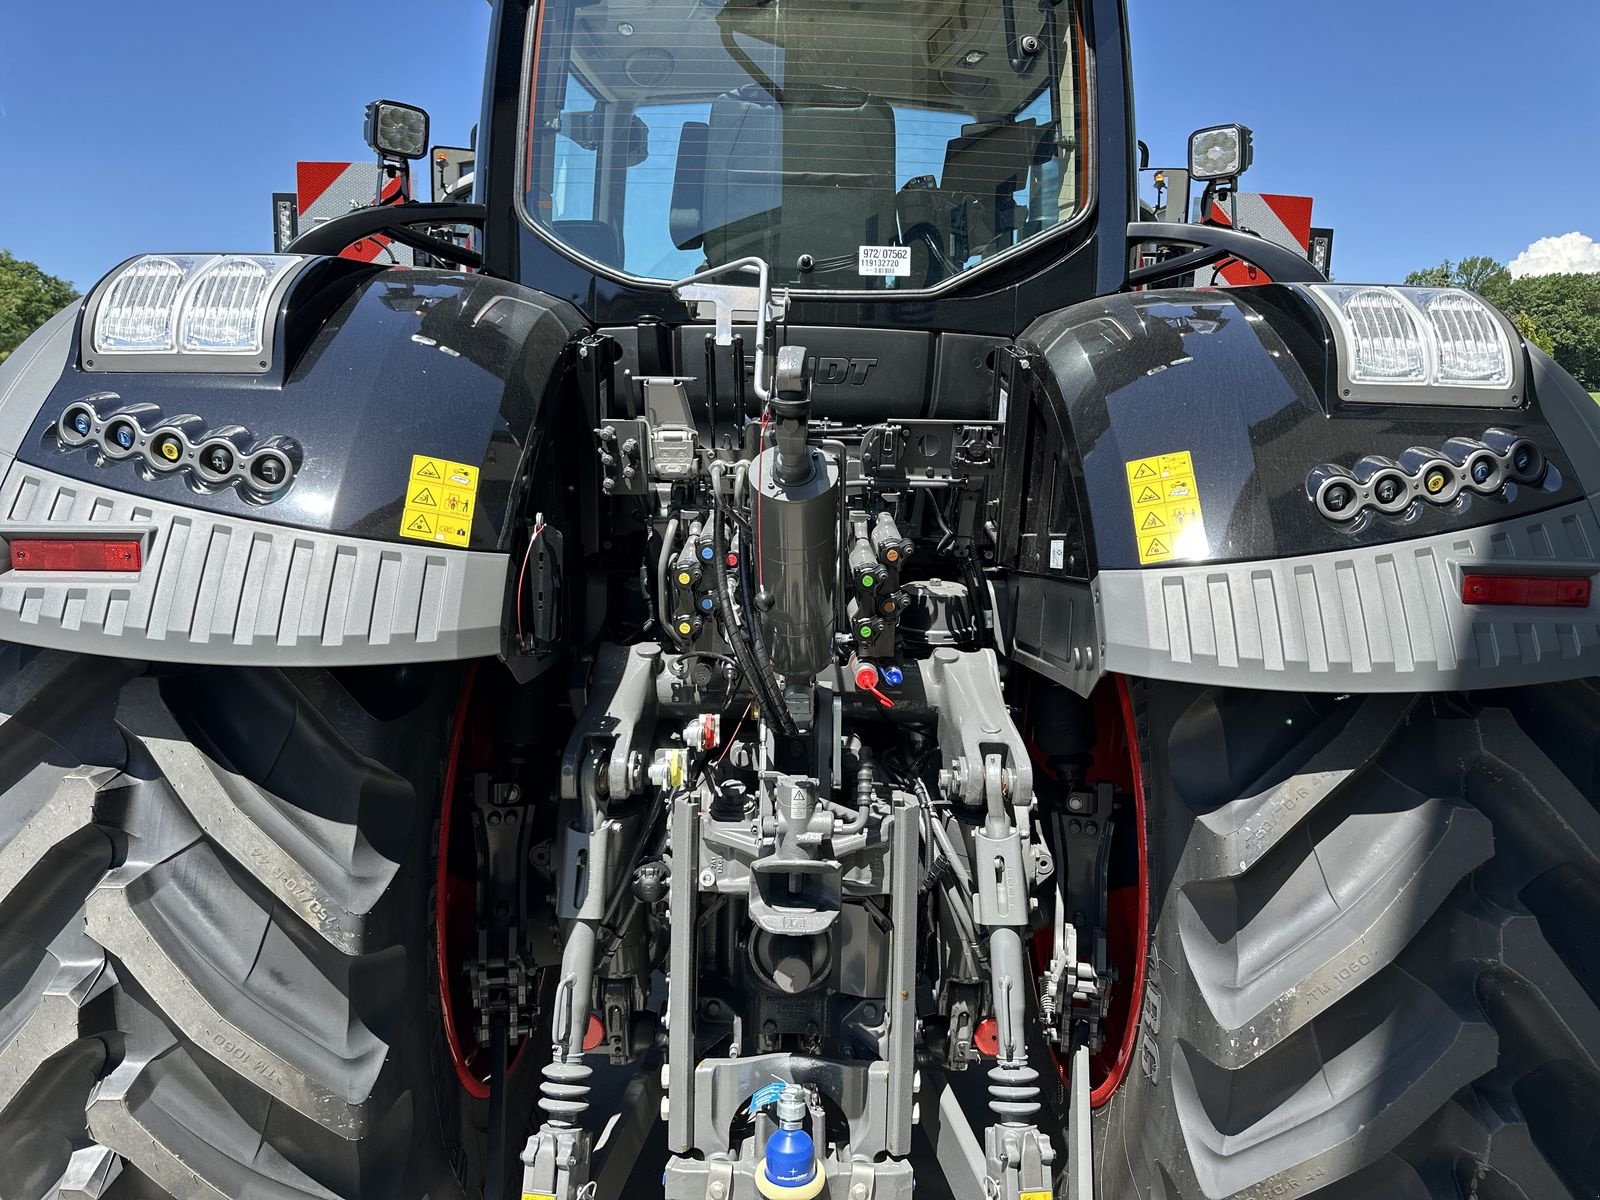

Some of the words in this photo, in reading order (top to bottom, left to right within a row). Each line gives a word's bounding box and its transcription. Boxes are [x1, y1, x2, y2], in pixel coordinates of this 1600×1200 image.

[861, 259, 899, 267] 119132720
[1306, 982, 1332, 1001] TM
[1333, 954, 1371, 984] 1060
[213, 1034, 251, 1064] 1060
[253, 1060, 276, 1081] TM
